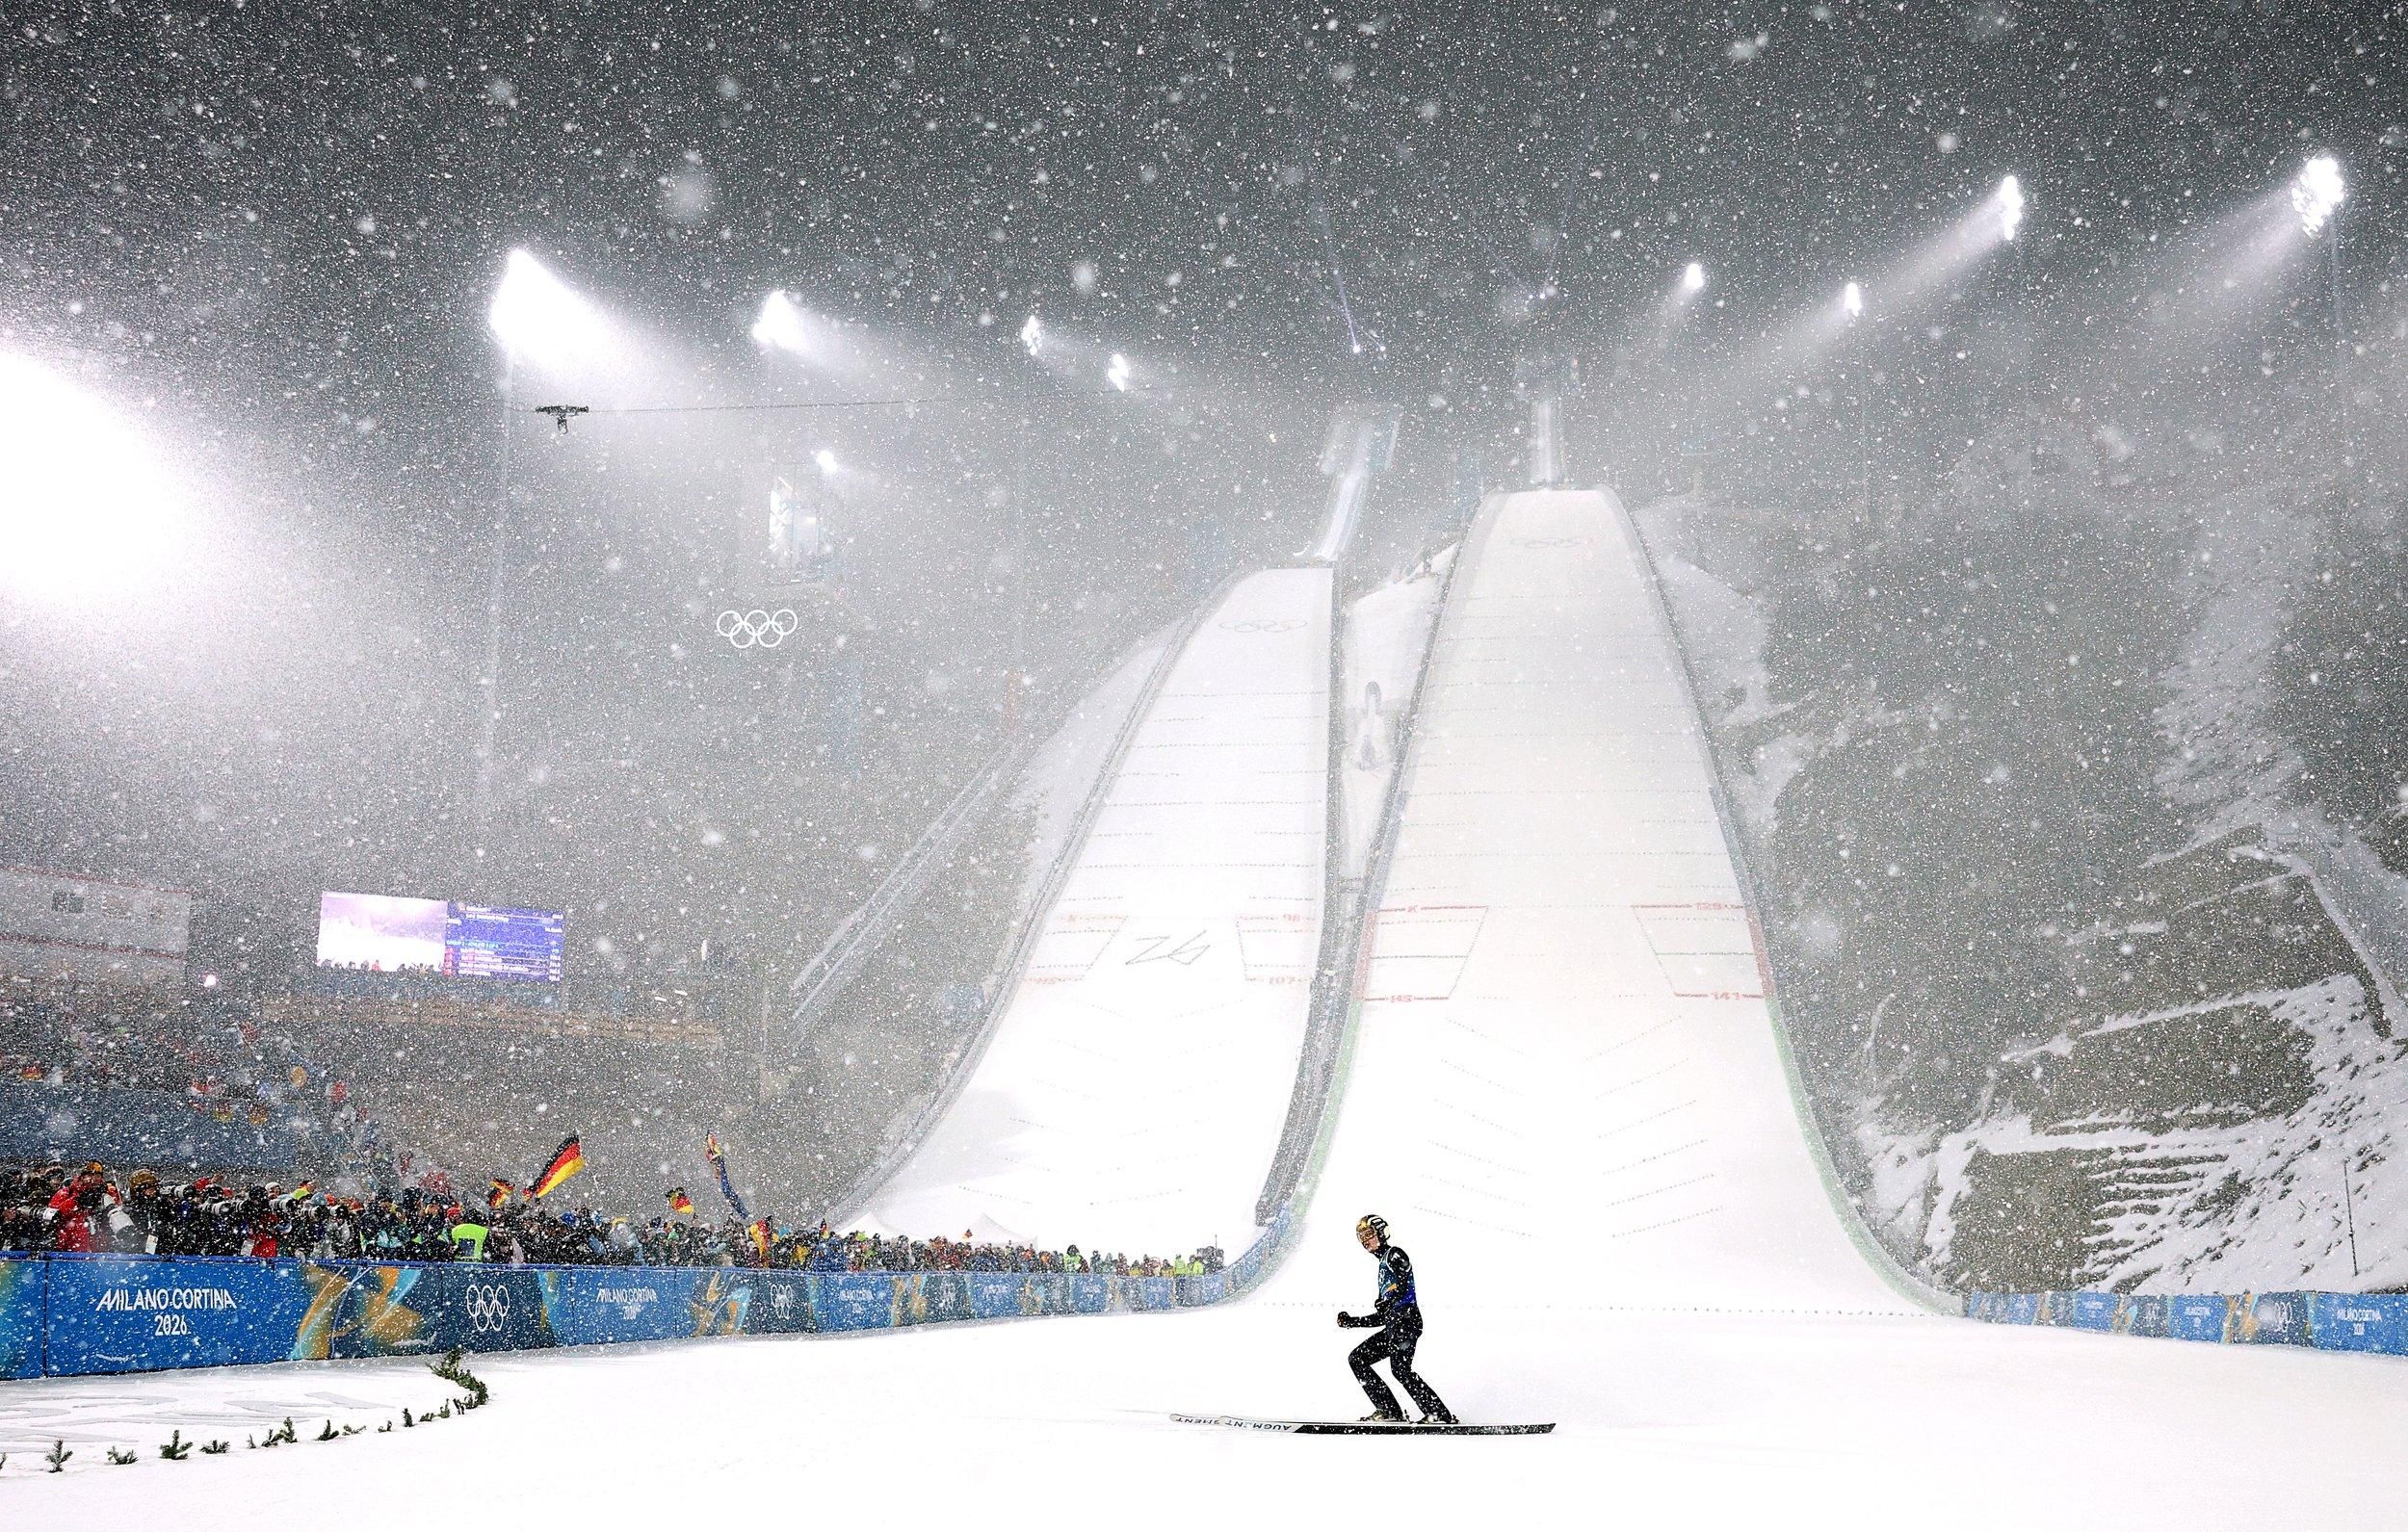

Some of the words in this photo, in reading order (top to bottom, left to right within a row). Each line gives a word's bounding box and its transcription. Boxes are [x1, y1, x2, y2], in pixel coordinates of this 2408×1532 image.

[95, 1288, 169, 1311] MILANO
[171, 1288, 237, 1310] CORTINA
[155, 1314, 188, 1336] 2026
